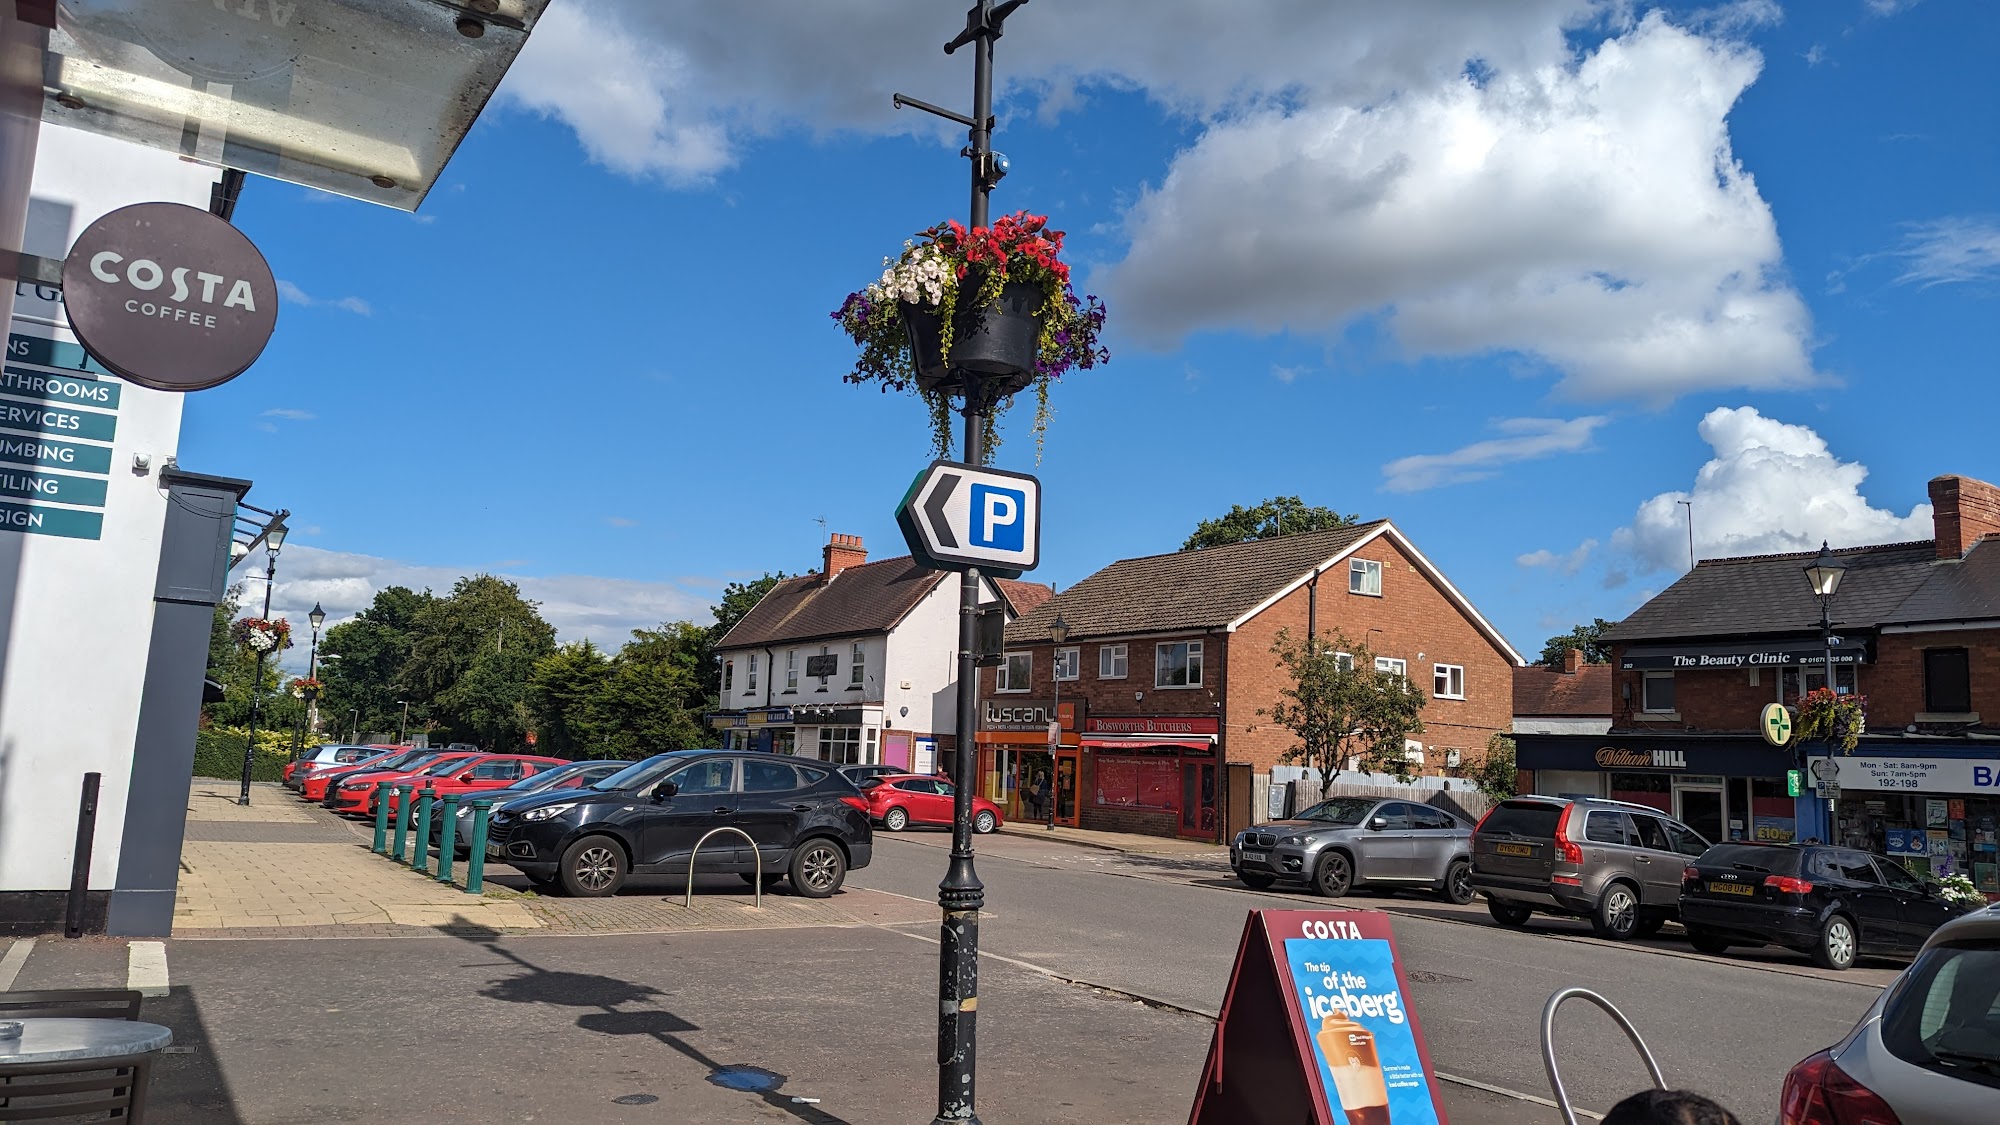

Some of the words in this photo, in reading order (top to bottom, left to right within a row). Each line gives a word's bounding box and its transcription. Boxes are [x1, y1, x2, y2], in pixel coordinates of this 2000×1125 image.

[90, 251, 256, 312] COSTA
[124, 299, 217, 329] COFFEE
[983, 492, 1017, 542] P
[1672, 655, 1697, 667] The
[1699, 655, 1746, 668] Beauty
[1748, 652, 1791, 664] Clinic
[1096, 719, 1145, 731] BOSWORTHS
[1146, 719, 1192, 732] BUTCHERS
[1595, 746, 1652, 767] William
[1652, 750, 1687, 767] HILL
[1890, 770, 1927, 778] 7am-5pm
[1900, 762, 1938, 770] 8am-9pm
[1878, 778, 1918, 788] 192-198
[1302, 920, 1362, 940] COSTA
[1304, 962, 1319, 972] The
[1320, 962, 1331, 974] tip
[1323, 971, 1339, 989] of
[1342, 971, 1367, 989] the
[1304, 986, 1404, 1024] iceberg
